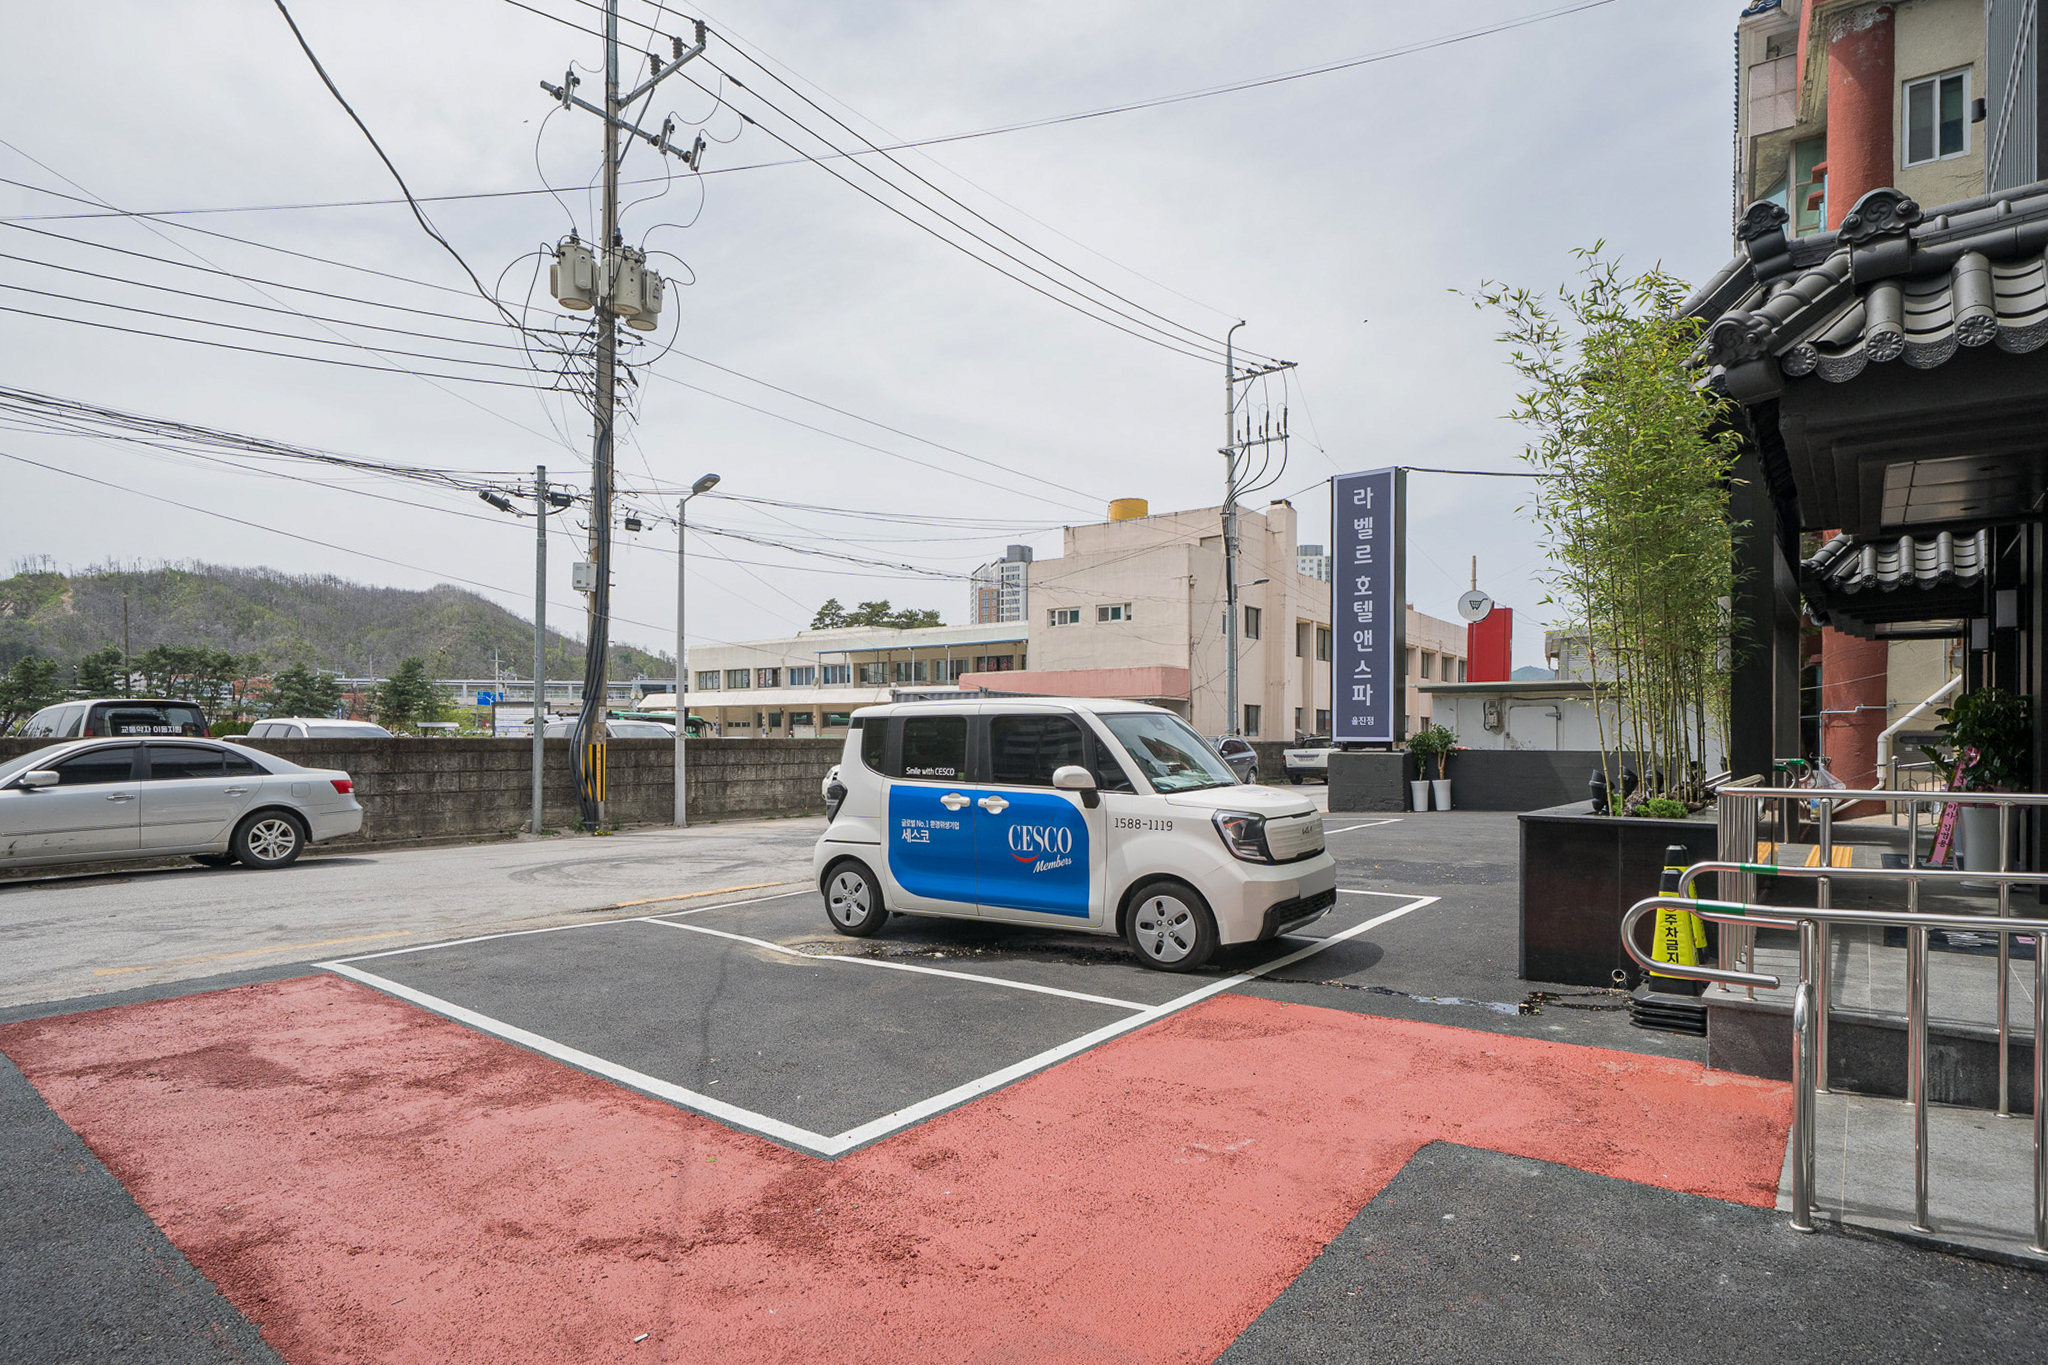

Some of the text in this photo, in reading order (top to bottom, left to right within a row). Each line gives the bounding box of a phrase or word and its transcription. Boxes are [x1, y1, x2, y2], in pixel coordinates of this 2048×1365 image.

[906, 766, 955, 776] Smile with CESCO
[901, 818, 915, 828] 글로벌
[930, 820, 960, 830] 환경위생기업
[1114, 817, 1173, 831] 1588-1119
[901, 828, 930, 843] 세스코
[1008, 824, 1073, 854] CESCO
[1032, 854, 1073, 874] Members
[1664, 913, 1680, 964] 주차금지
